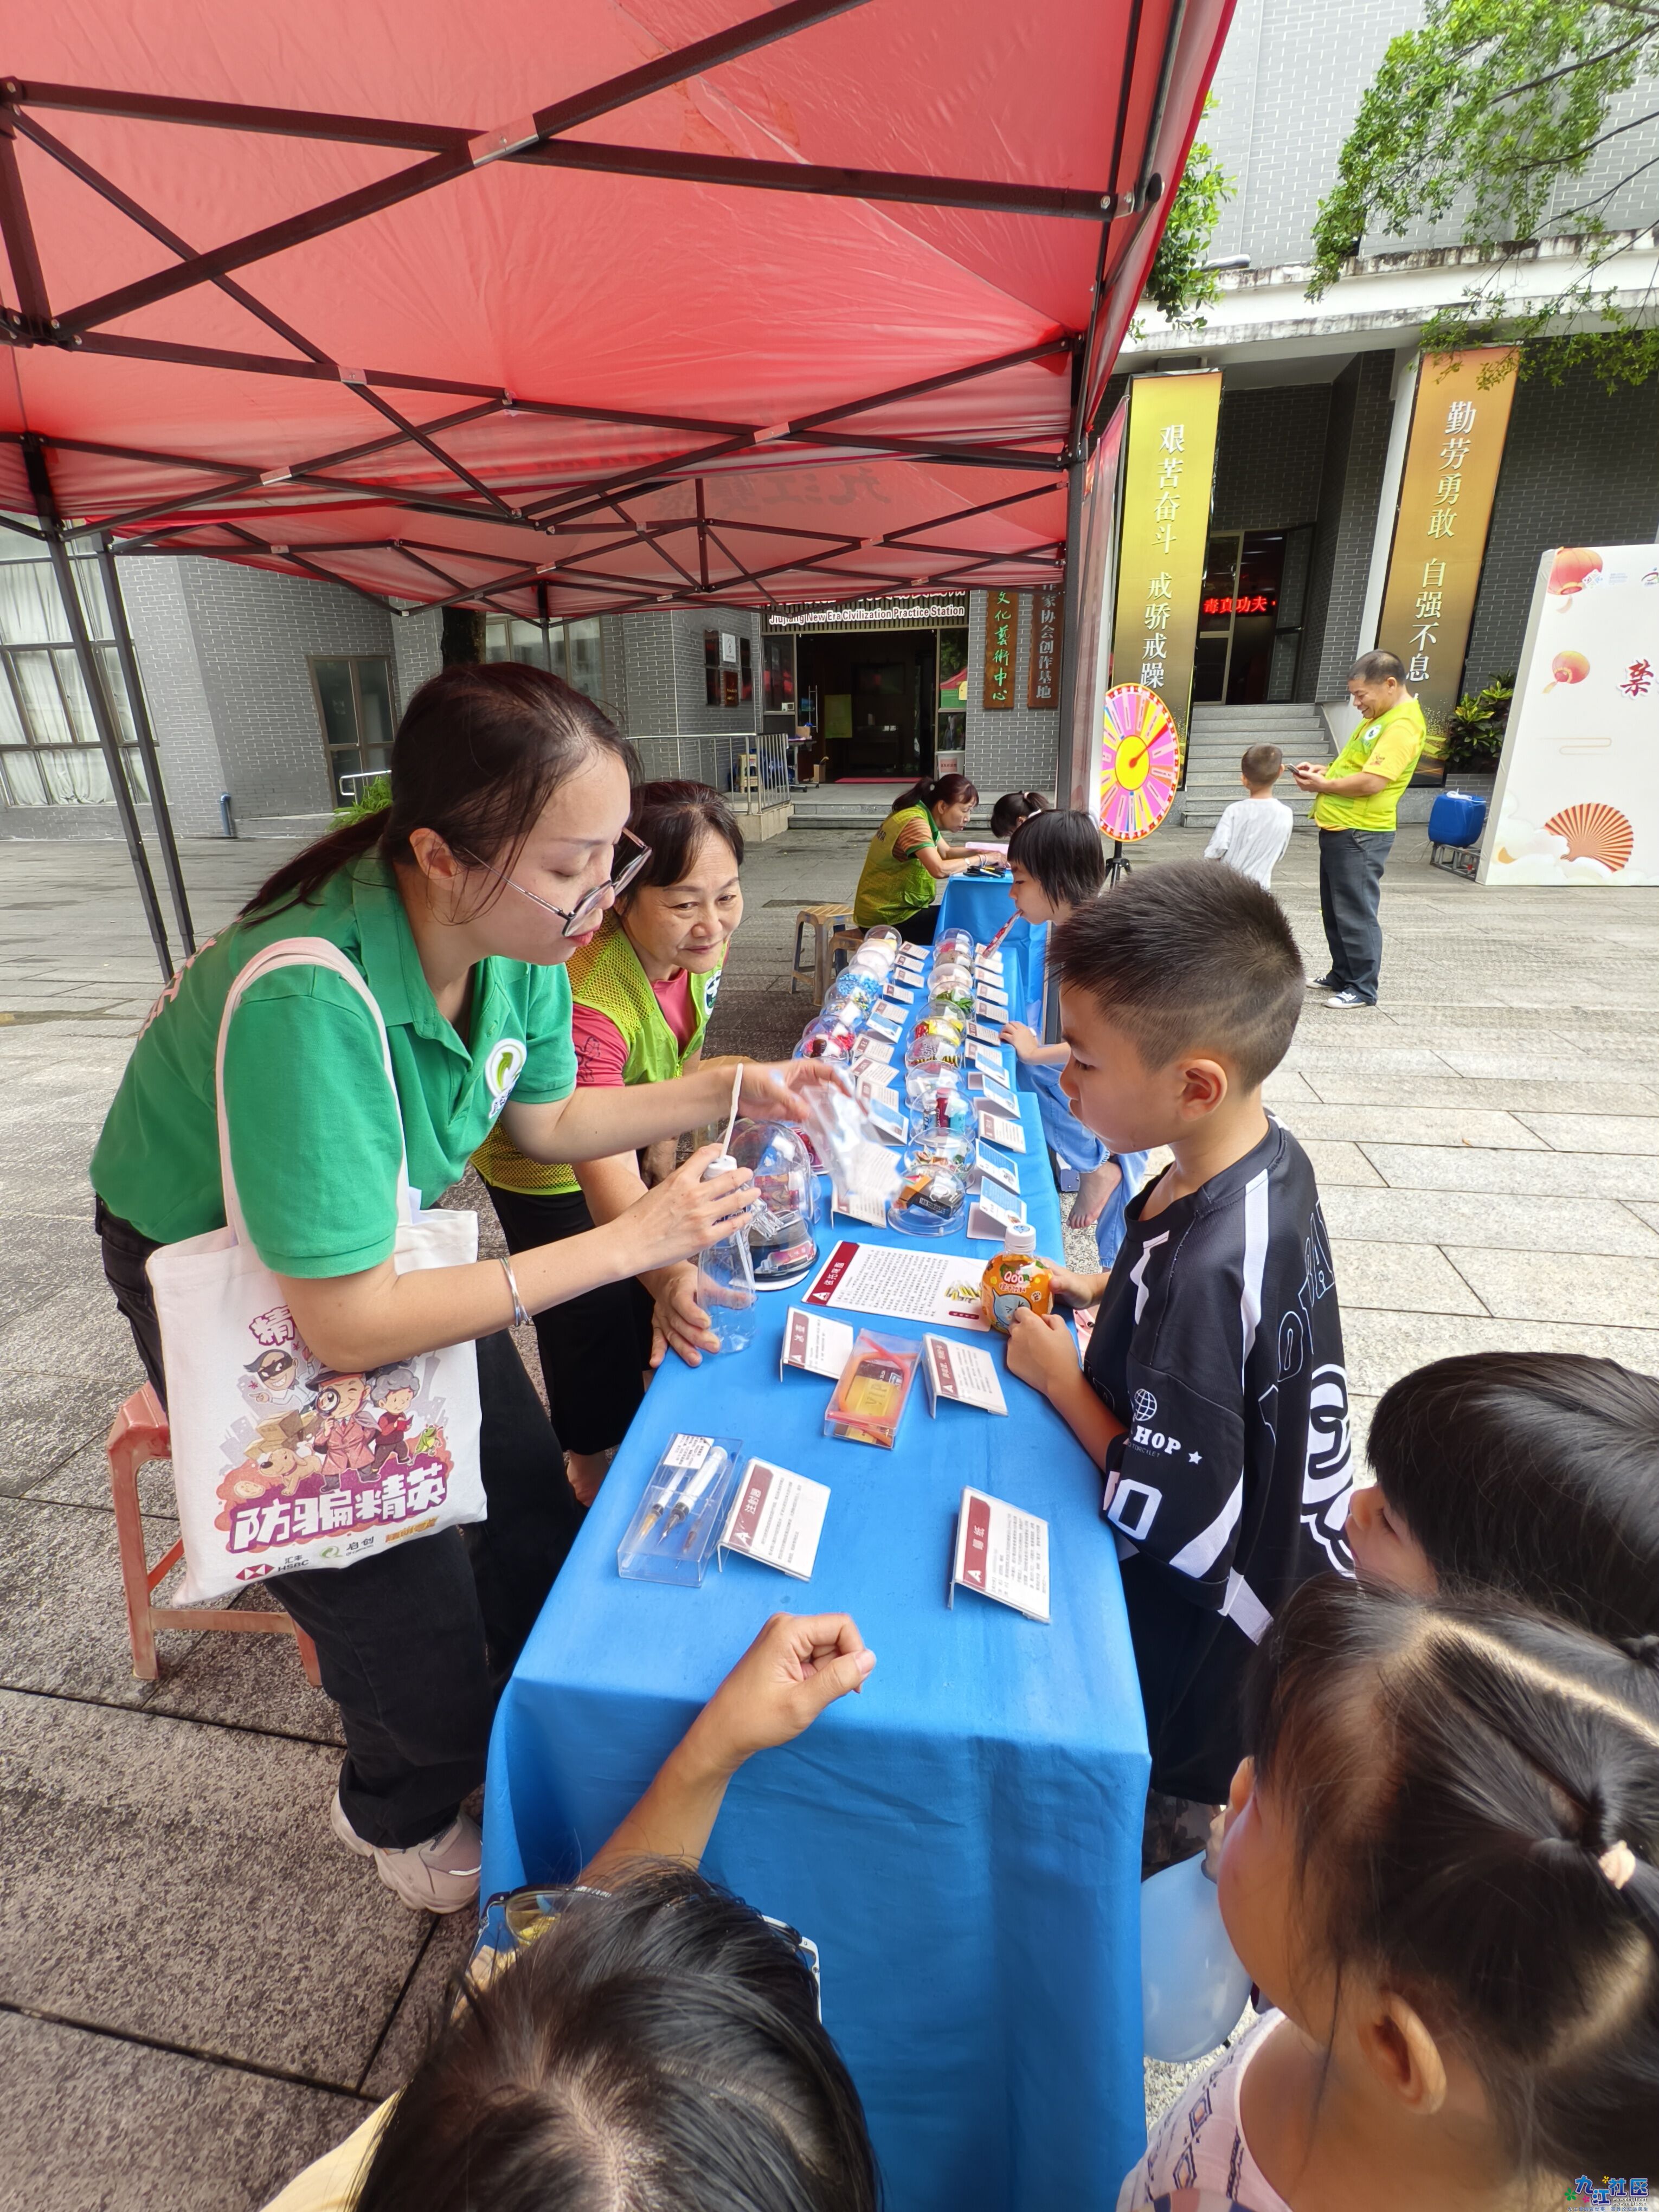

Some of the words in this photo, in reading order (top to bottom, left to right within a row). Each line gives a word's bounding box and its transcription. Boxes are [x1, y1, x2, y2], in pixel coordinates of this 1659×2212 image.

[1151, 423, 1185, 554] 艰苦奋斗
[1427, 400, 1477, 539] 勤劳勇敢
[806, 613, 826, 622] New
[827, 610, 841, 621] Era
[893, 607, 929, 619] Practice
[931, 605, 964, 616] Station
[993, 591, 1011, 700] 文化藝術中心
[1141, 571, 1173, 689] 戒骄戒躁
[1406, 558, 1447, 682] 自强不息
[1004, 1270, 1025, 1284] Qoo
[1133, 1425, 1181, 1455] HOP
[234, 1463, 446, 1551] 防骗精英
[278, 1559, 309, 1572] HSBC
